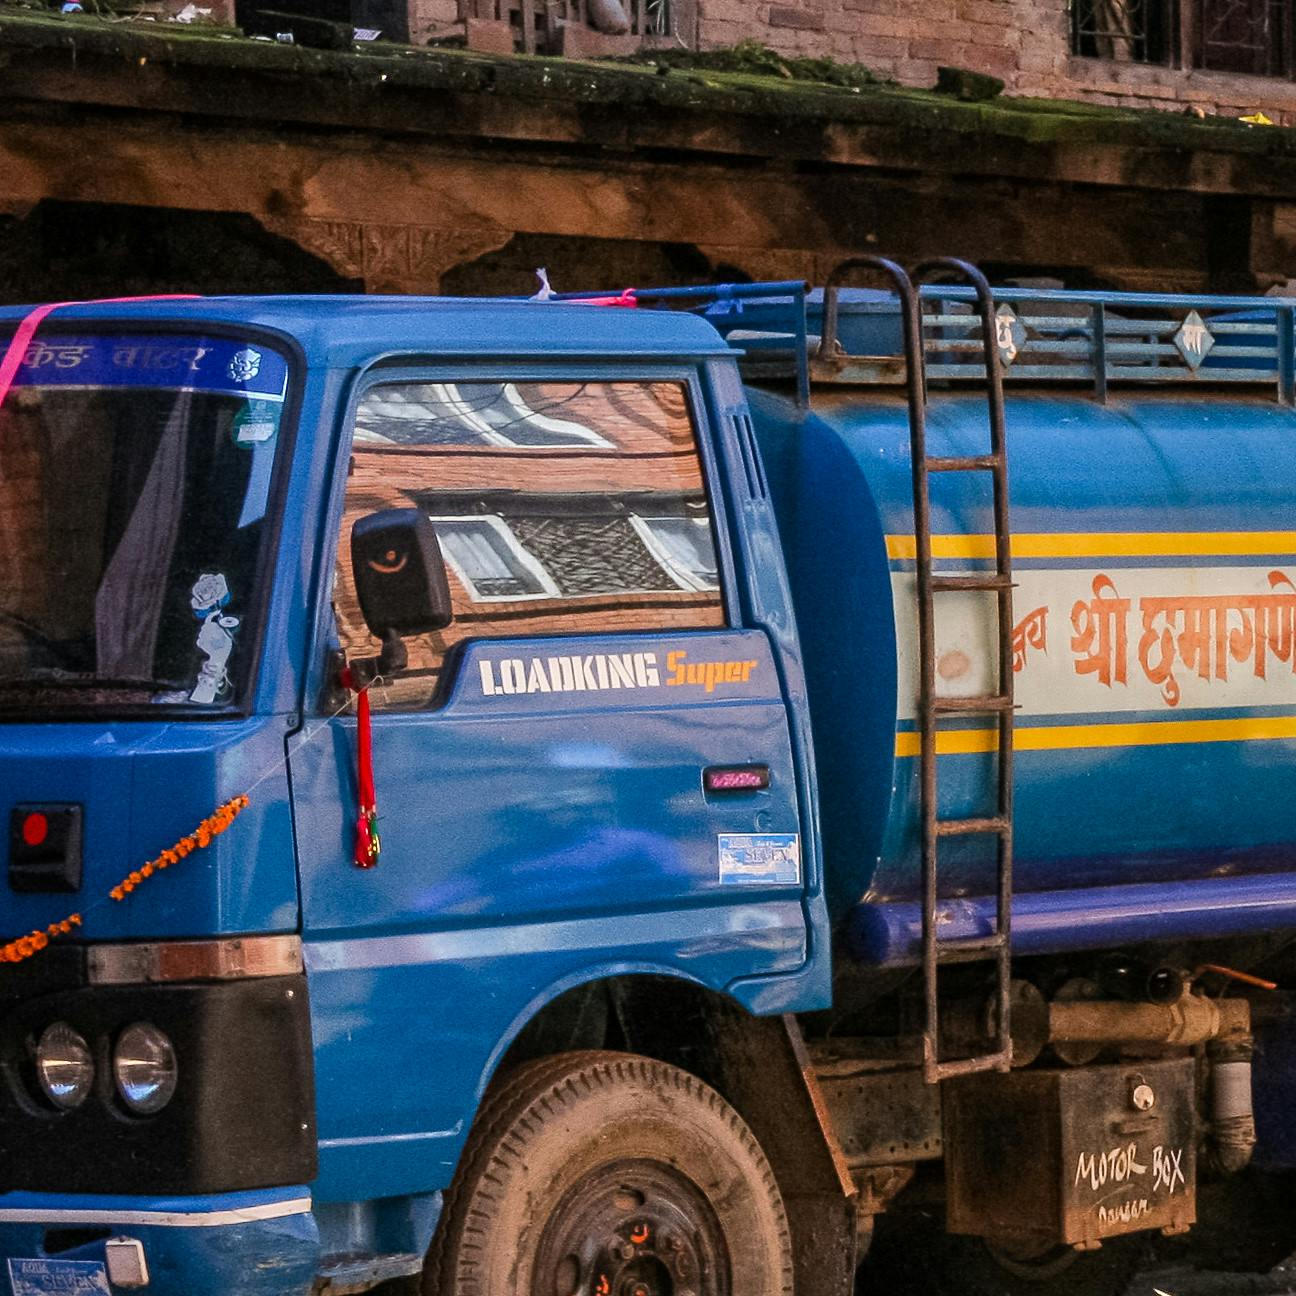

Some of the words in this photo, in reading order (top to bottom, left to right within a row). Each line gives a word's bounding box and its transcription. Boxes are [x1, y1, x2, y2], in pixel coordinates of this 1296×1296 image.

[1069, 572, 1132, 689] श्री
[479, 652, 661, 696] LOADKING
[666, 651, 758, 693] Super
[1074, 1141, 1147, 1191] MOTOR
[1152, 1145, 1185, 1195] BOX
